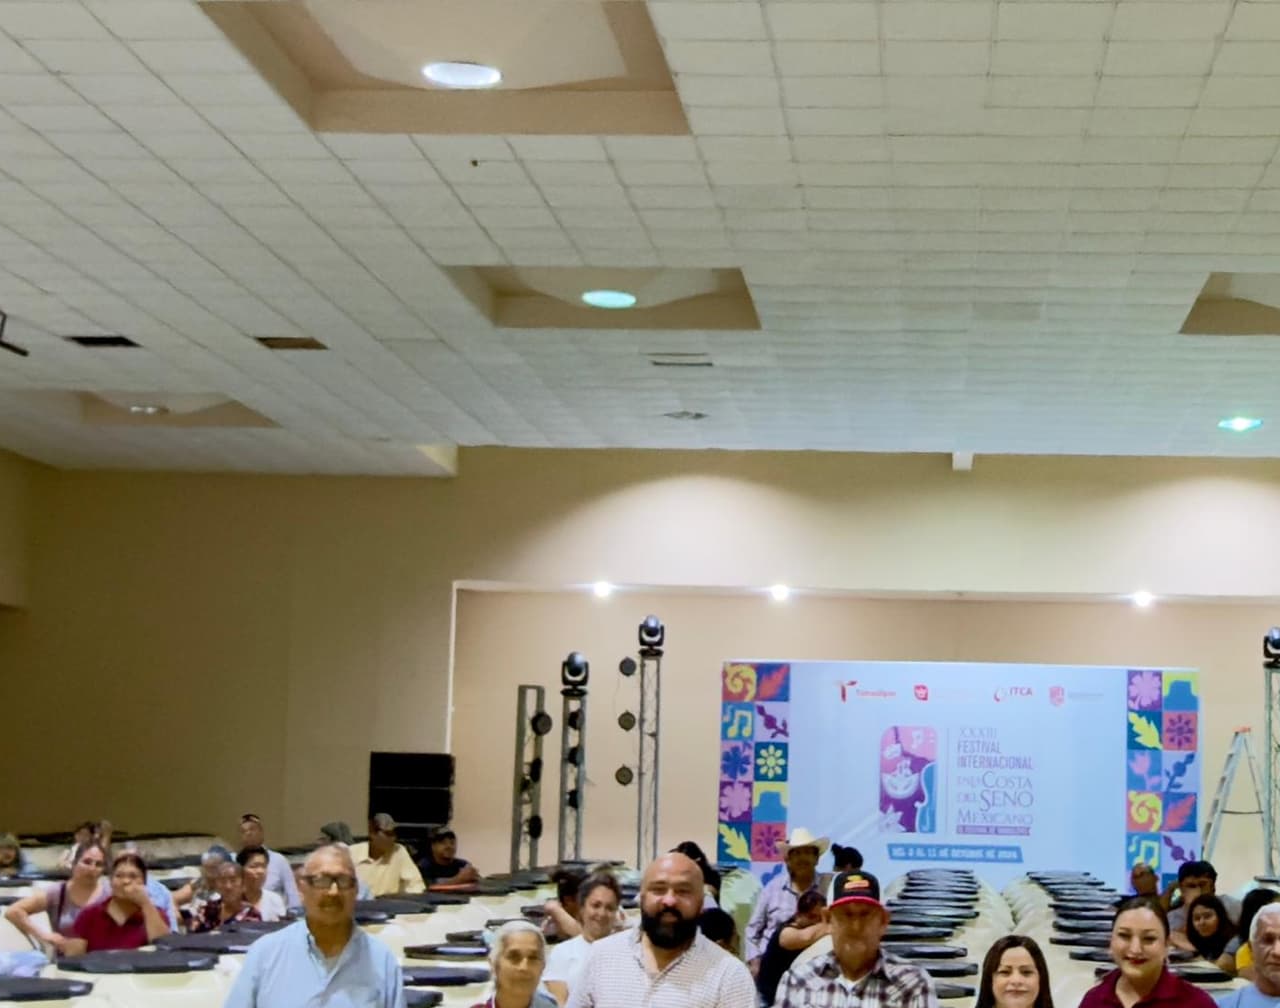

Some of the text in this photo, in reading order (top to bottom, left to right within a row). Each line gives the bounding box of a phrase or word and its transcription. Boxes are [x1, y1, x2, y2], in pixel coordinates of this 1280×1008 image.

[1009, 686, 1033, 697] ITCA
[957, 739, 1001, 753] FESTIVAL
[957, 754, 1034, 770] INTERNACIONAL
[982, 769, 1033, 789] COSTA
[979, 788, 1035, 812] SENO
[957, 807, 1034, 825] MEXICANO
